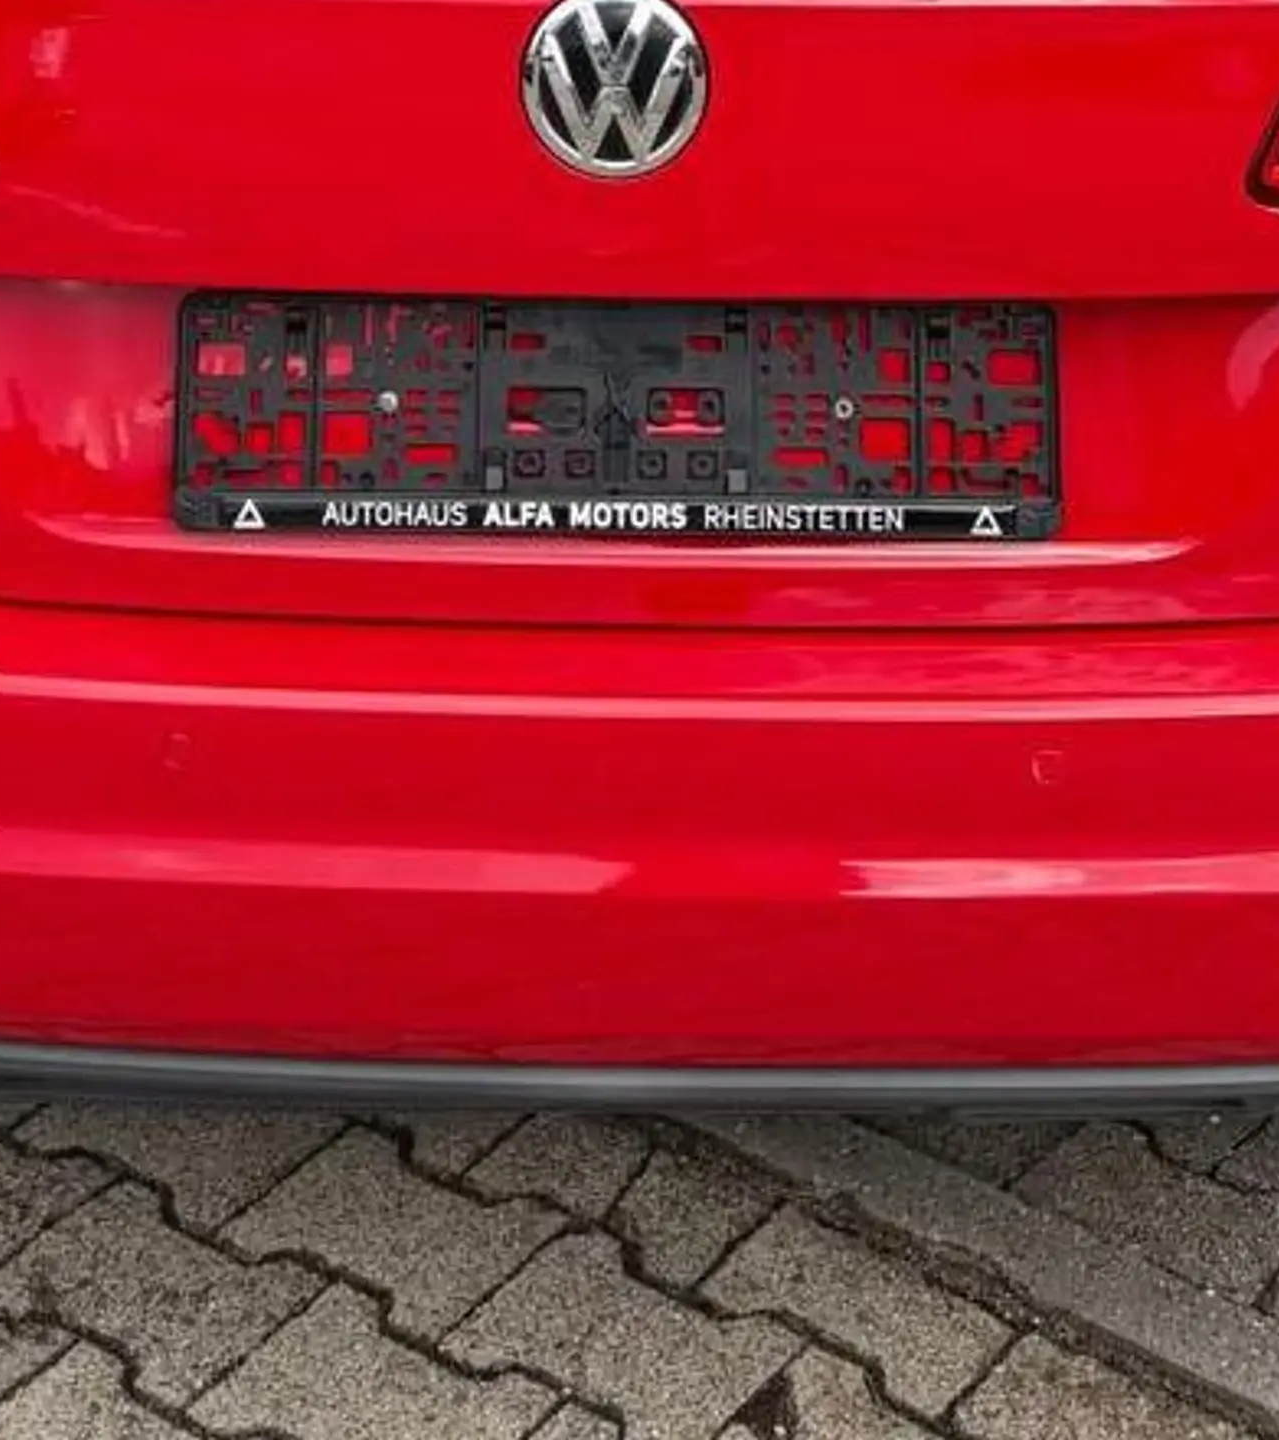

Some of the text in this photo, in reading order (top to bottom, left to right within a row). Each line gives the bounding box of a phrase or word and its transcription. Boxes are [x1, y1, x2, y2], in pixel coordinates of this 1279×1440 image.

[321, 499, 906, 532] AUTOHAUS ALFA MOTORS RHEINSTETTEN
